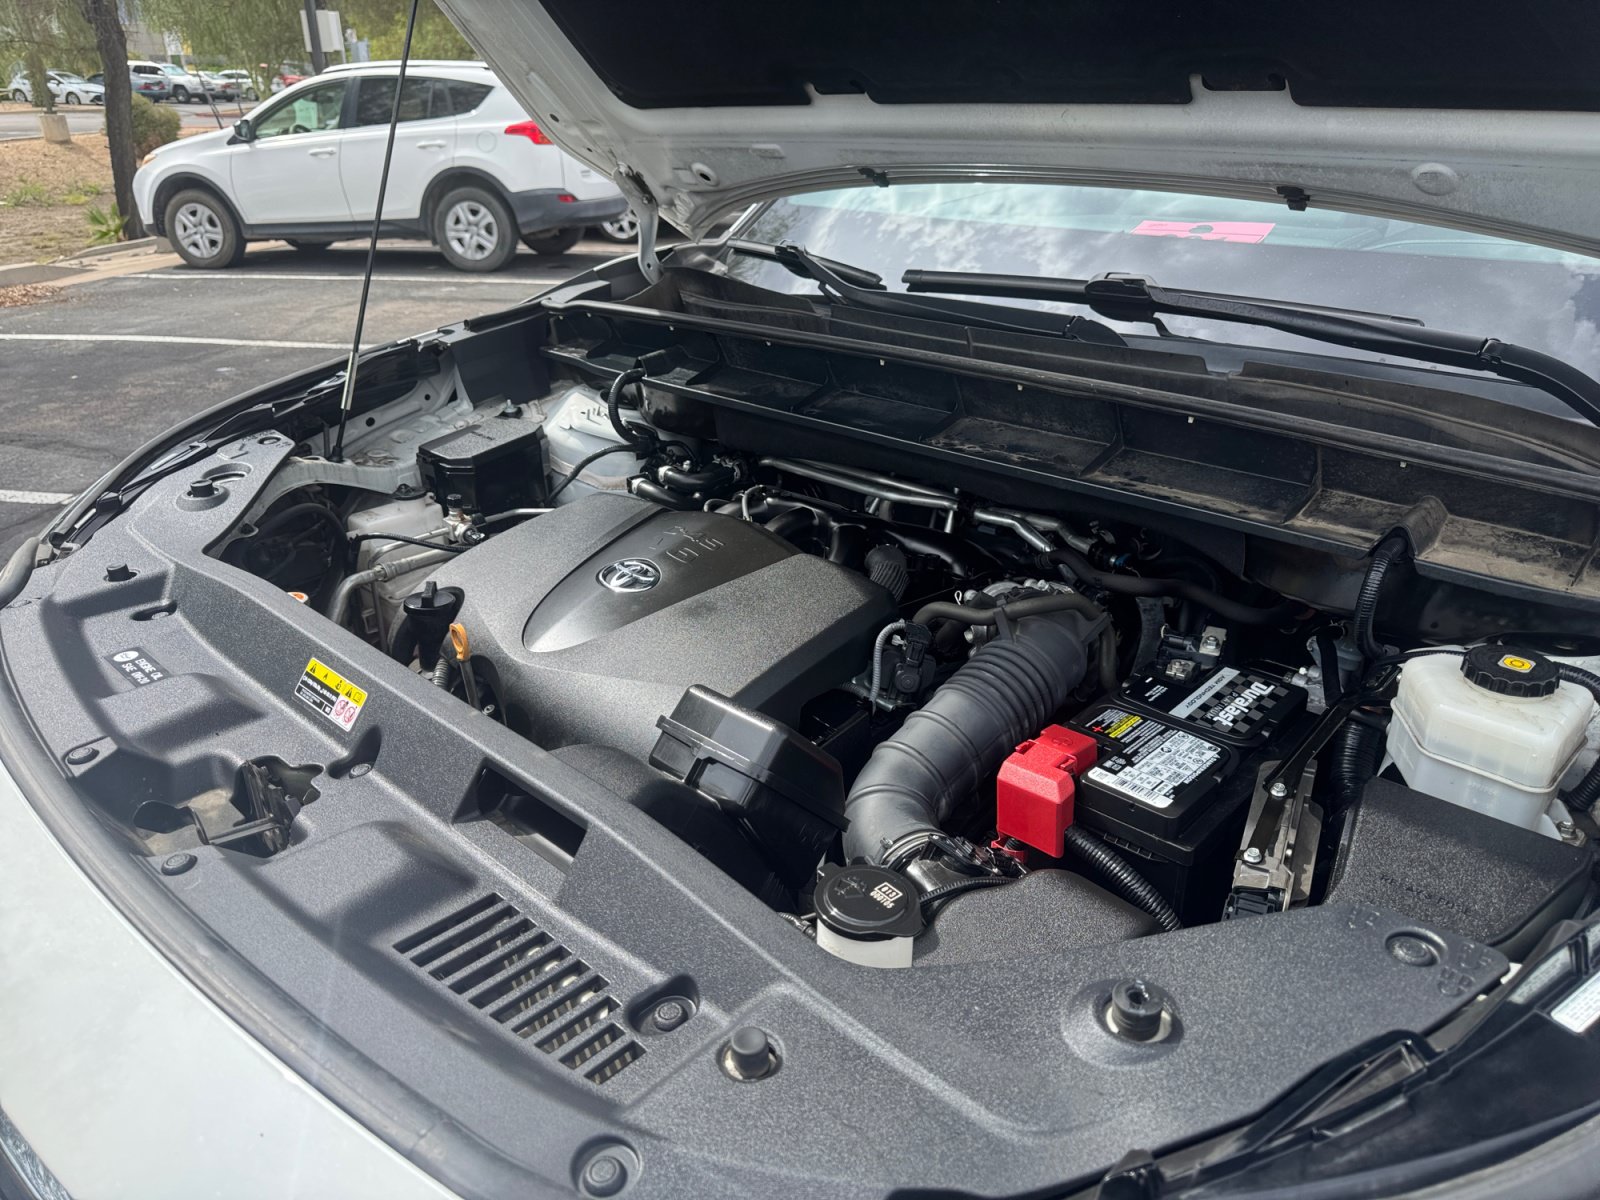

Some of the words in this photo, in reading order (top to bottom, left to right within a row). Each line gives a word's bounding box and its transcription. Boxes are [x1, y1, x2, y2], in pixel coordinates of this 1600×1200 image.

[1186, 683, 1217, 709] TECHNOLOGY
[1206, 692, 1238, 719] PLATINUM
[1213, 682, 1275, 727] Duralast
